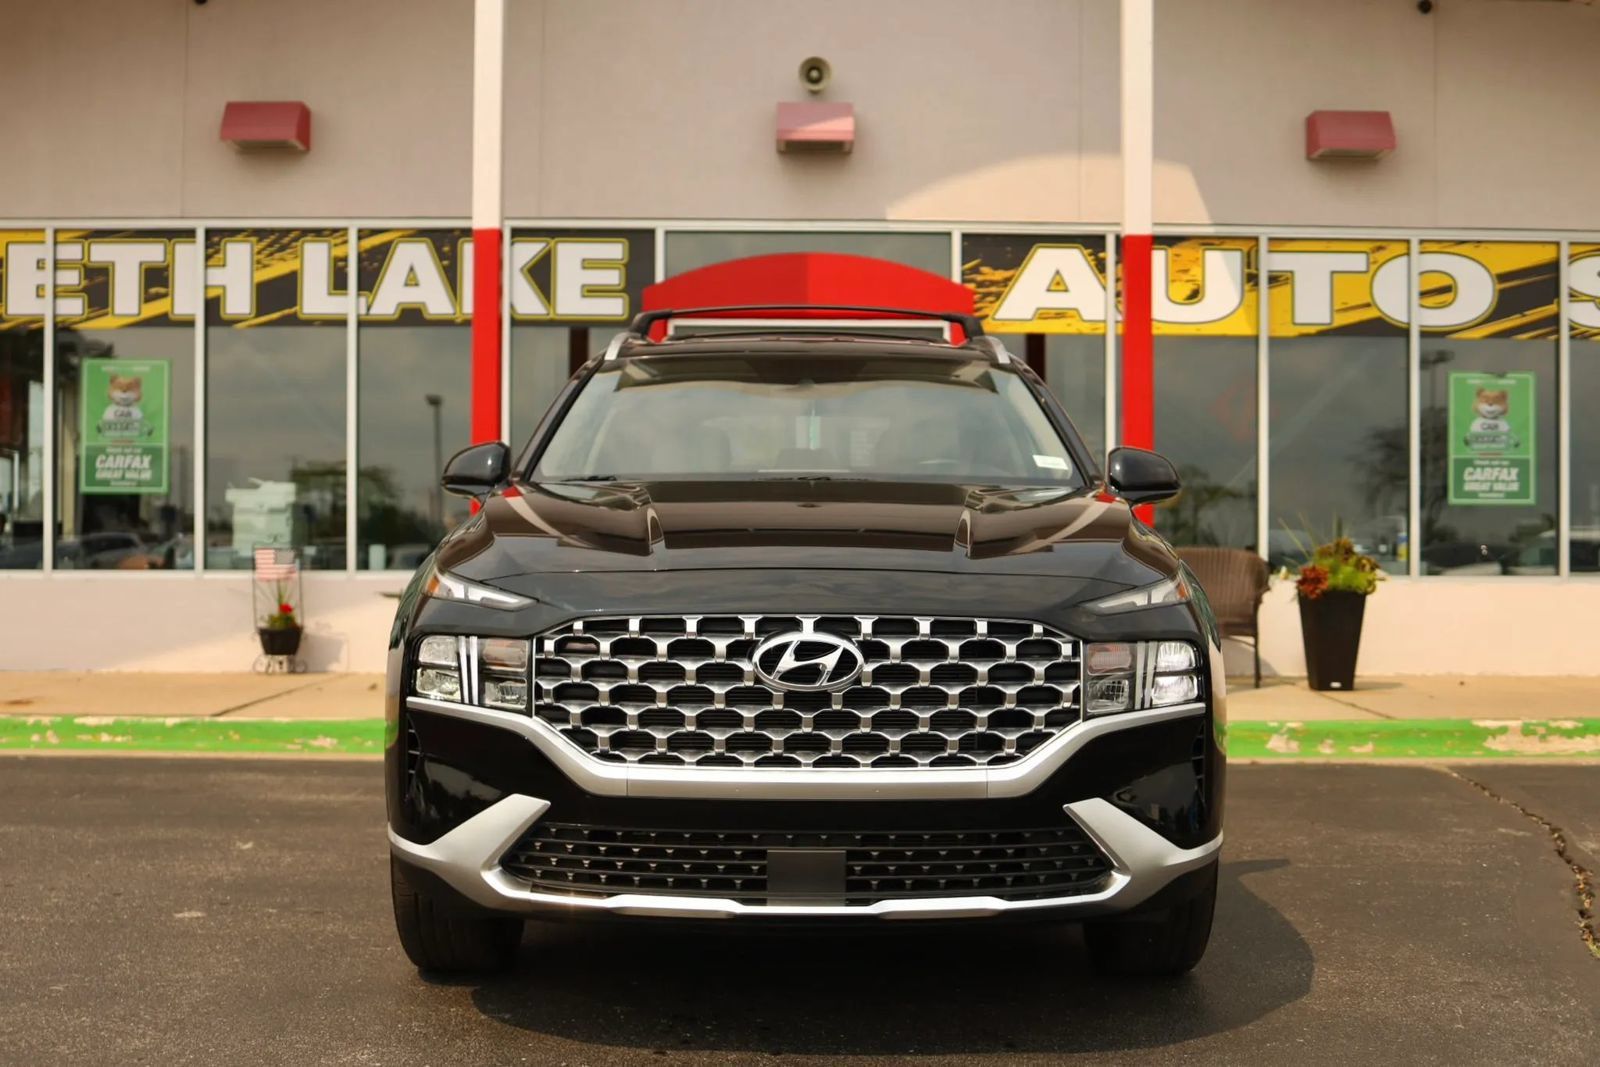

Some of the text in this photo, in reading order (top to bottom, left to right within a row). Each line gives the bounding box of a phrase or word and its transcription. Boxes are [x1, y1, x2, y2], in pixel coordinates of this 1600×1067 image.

[990, 244, 1497, 330] AUTO
[95, 454, 152, 469] CARFAX
[1463, 467, 1519, 481] CARFAX
